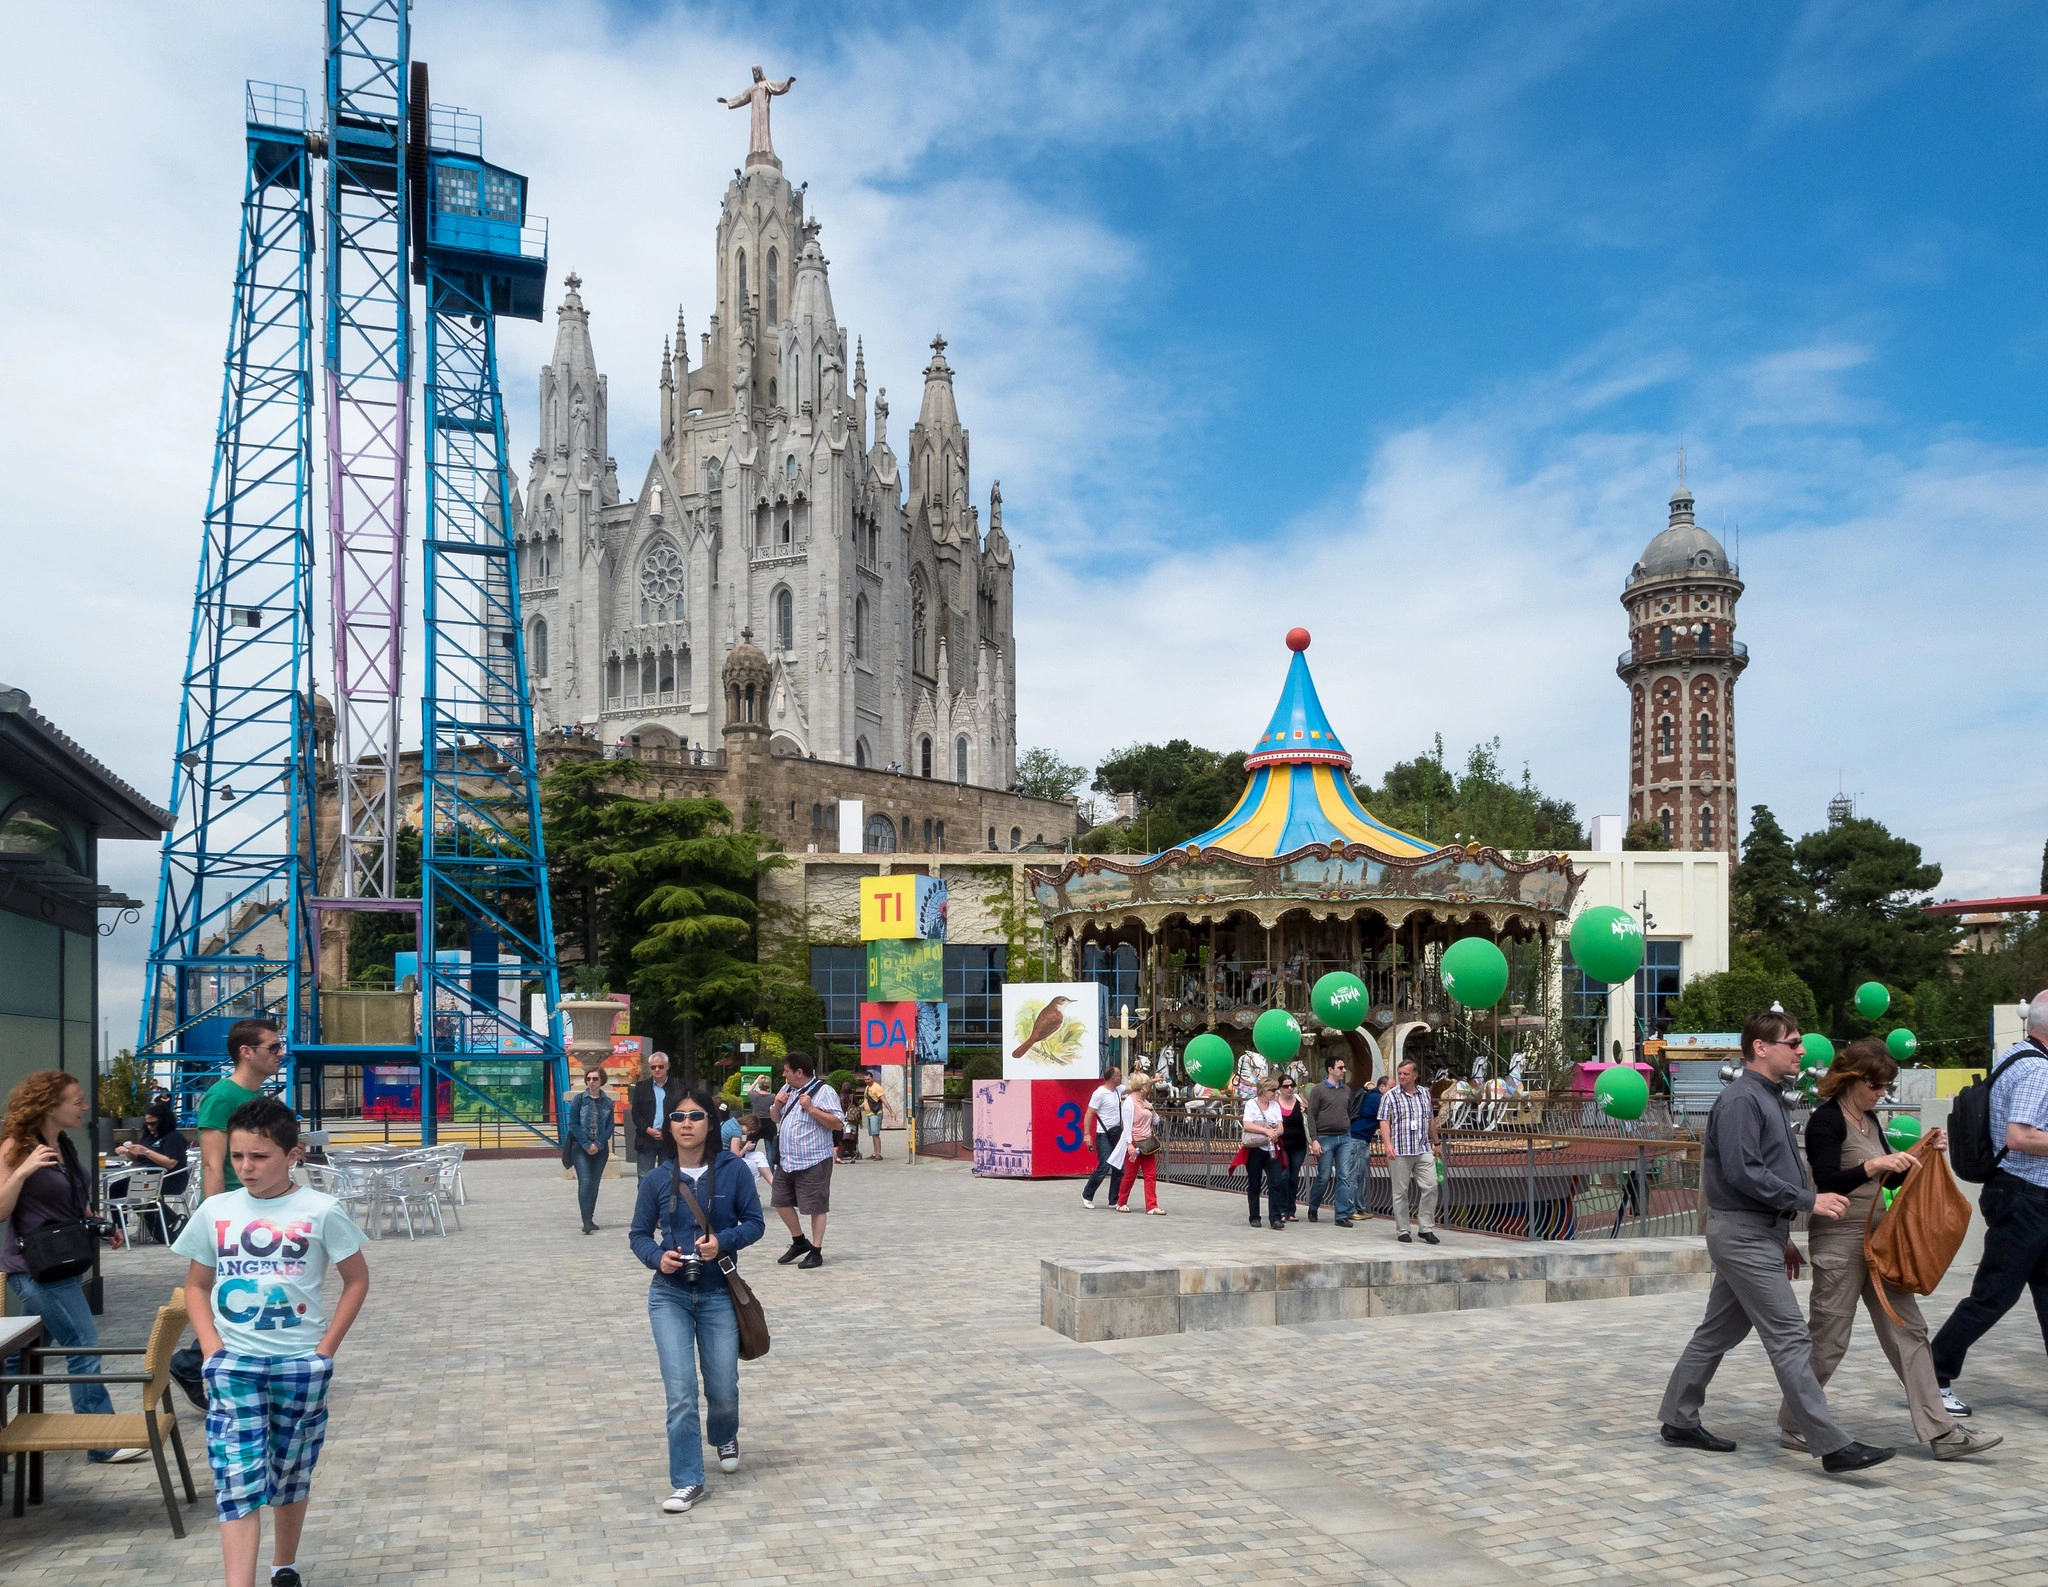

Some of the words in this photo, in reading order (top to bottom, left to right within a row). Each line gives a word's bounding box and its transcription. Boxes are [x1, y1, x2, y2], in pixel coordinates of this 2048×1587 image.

[874, 892, 901, 922] TI
[869, 957, 878, 988] BI
[1330, 985, 1361, 1010] ACTIVIA
[867, 1019, 907, 1048] DA
[1056, 1101, 1084, 1153] 3
[215, 1218, 312, 1259] LOS
[218, 1260, 307, 1276] ANGELES
